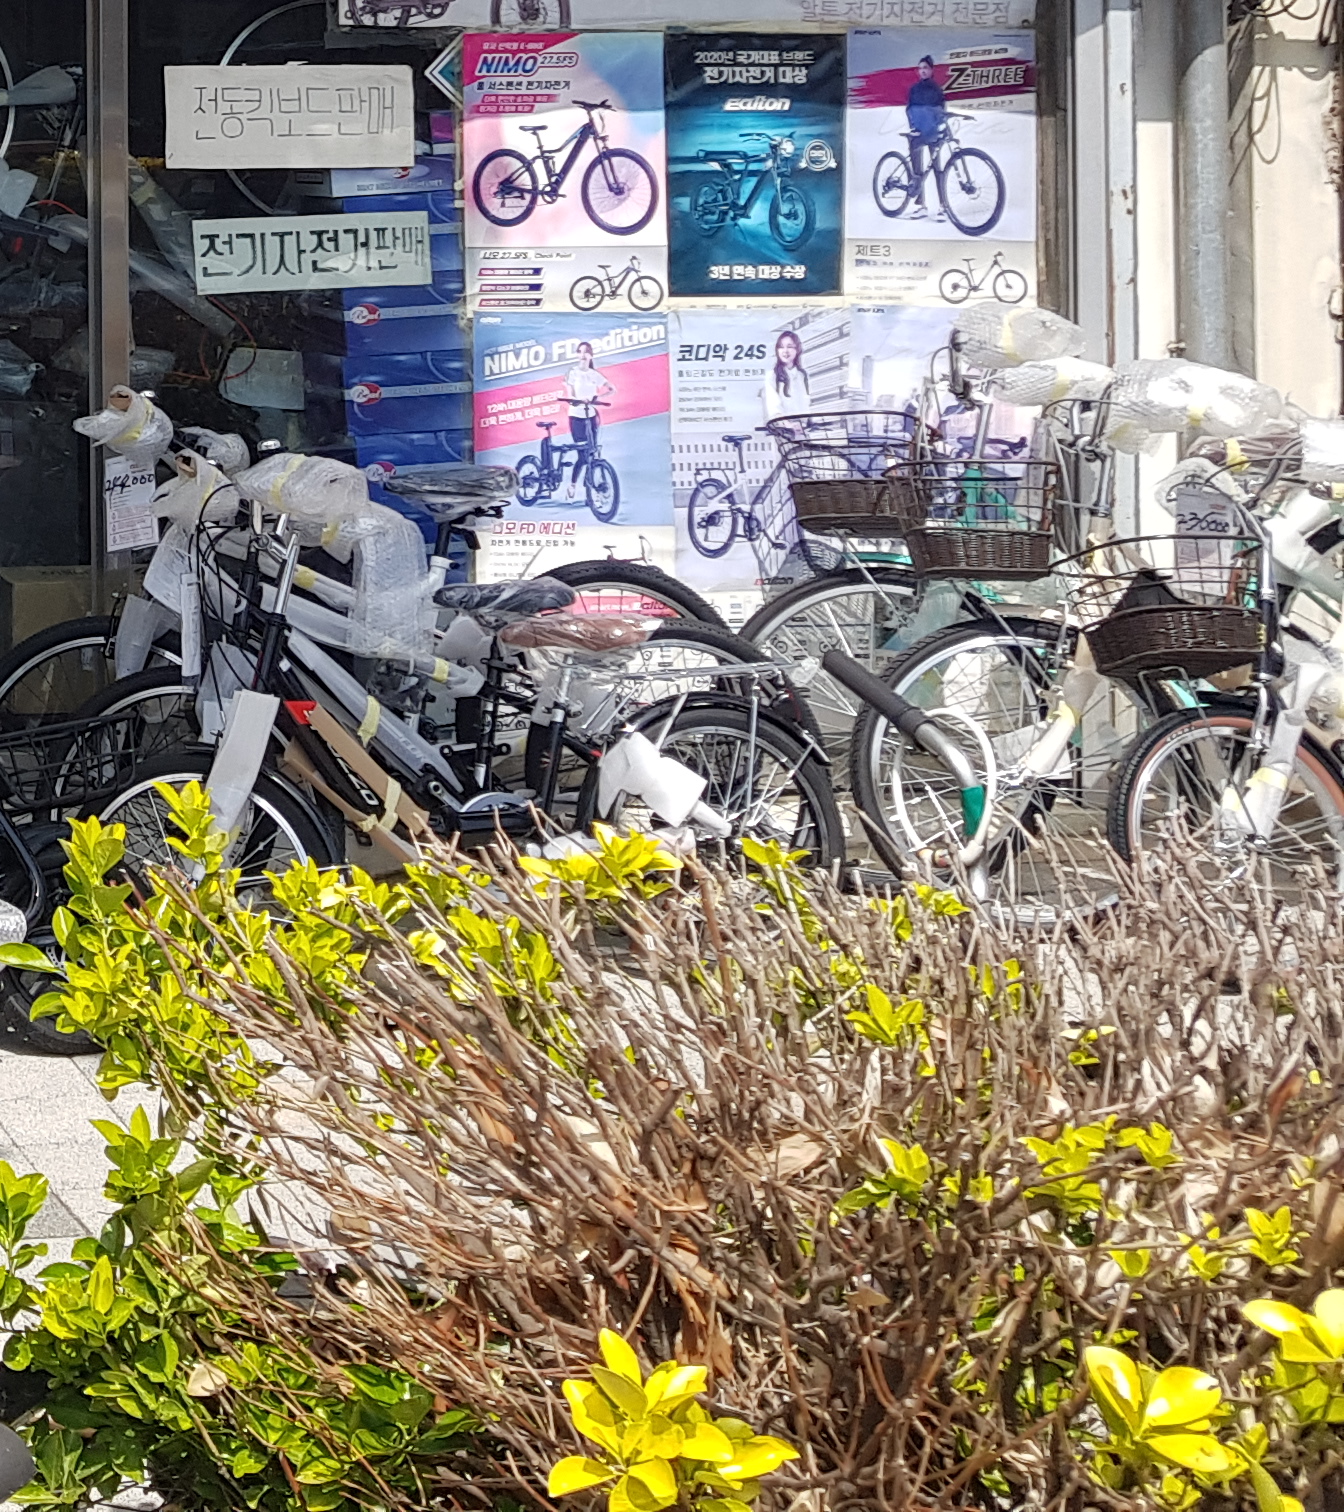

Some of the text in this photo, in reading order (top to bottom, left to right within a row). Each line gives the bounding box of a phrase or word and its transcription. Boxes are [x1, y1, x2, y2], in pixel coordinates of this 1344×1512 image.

[800, 0, 1012, 25] 알톤 전기자전거 전문점
[478, 54, 538, 74] NIMO
[694, 50, 815, 64] 2020년 국가대표 브랜드
[703, 67, 808, 83] 전기자전거 대상
[855, 245, 891, 257] 제트3
[709, 265, 806, 279] 3년 연속 대상 수상
[483, 344, 546, 376] NIMO
[552, 338, 581, 362] FD
[592, 324, 666, 354] edition
[677, 344, 767, 362] 코디악 24S
